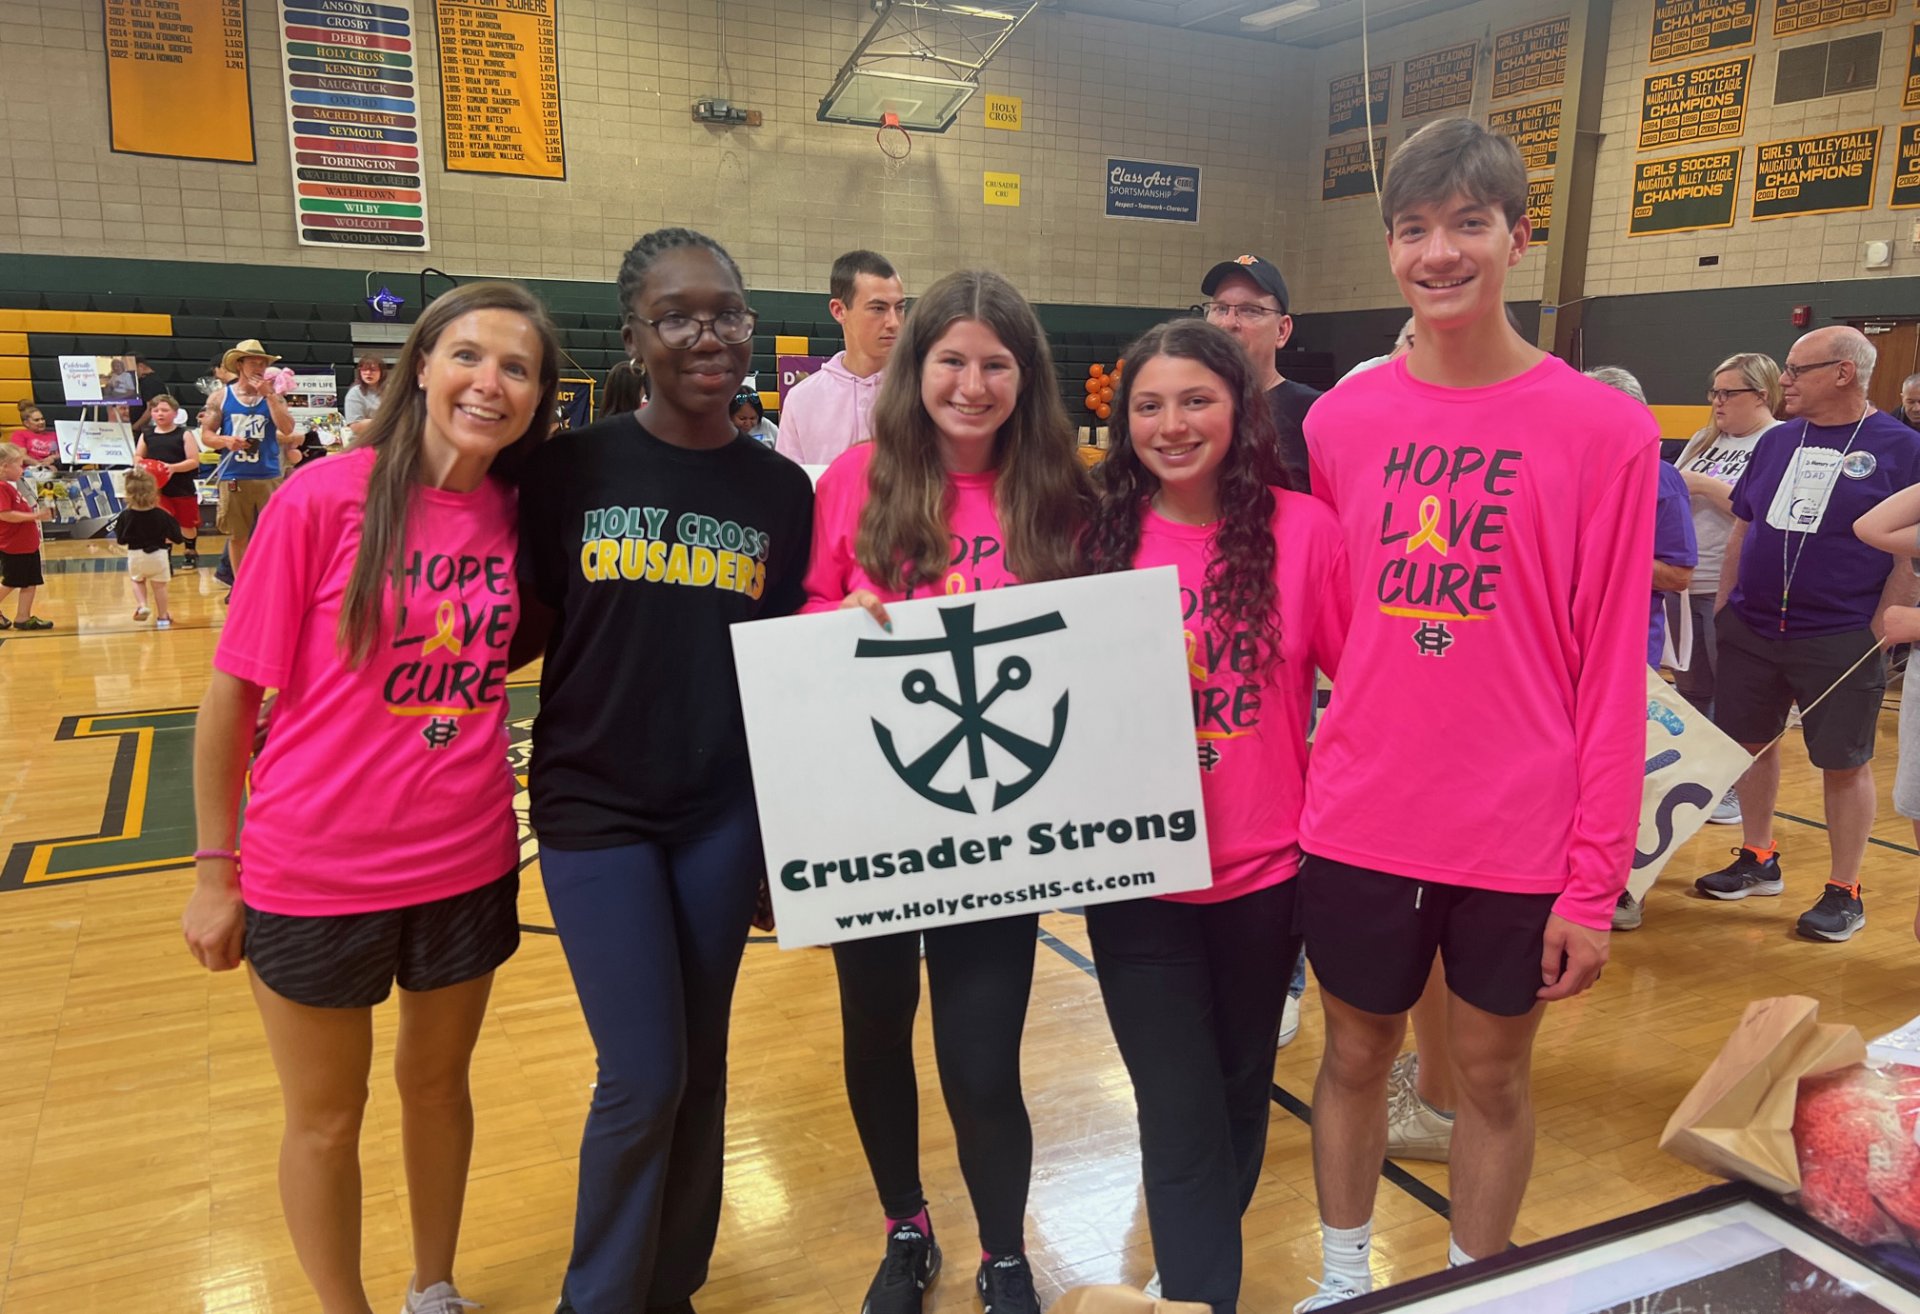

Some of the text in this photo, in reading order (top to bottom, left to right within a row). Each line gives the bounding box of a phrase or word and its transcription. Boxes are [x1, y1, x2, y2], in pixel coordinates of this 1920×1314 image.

[322, 1, 372, 14] ANSONIA
[1656, 1, 1694, 19] NAUGATUCK
[1662, 2, 1746, 31] CHAMPIONS
[326, 17, 370, 30] CROSBY
[1523, 21, 1568, 40] BASKETBAL
[331, 33, 368, 45] DERBY
[316, 47, 385, 62] HOLY CROSS
[1408, 47, 1472, 72] CHEERLEADING
[325, 64, 379, 77] KENNEDY
[1651, 64, 1741, 92] GIRLS SOCCER
[318, 79, 388, 93] NAUGATUCK
[1409, 71, 1467, 93] CHAMPIONS
[1646, 77, 1743, 106] NAUGATUCK VALLEY LEAGUE
[330, 96, 378, 108] OXFORD
[991, 102, 1017, 114] HOLY
[1651, 93, 1734, 118] CHAMPIONS
[313, 109, 396, 125] SACRED HEART
[989, 112, 1018, 123] CROSS
[1491, 102, 1561, 126] GIRLS BASKETBAL
[329, 126, 384, 139] SEYMOUR
[1511, 128, 1559, 145] AMPIONS
[1762, 133, 1872, 160] GIRLS VOLLEYBALL
[320, 156, 396, 170] TORRINGTON
[1643, 155, 1730, 178] GIRLS SOCCER
[1759, 147, 1873, 175] NAUGATUCK VALLEY LEAGUE
[304, 170, 414, 186] WATERBURY CAREER
[1110, 166, 1142, 185] Class
[1143, 171, 1172, 188] Act
[1637, 168, 1733, 192] NAUGATUCK VALLEY LEAGUE
[1766, 163, 1863, 187] CHAMPIONS
[1899, 176, 1918, 186] 2002
[326, 187, 396, 199] WATERTOWN
[985, 180, 1018, 189] CRUSADER
[1110, 186, 1172, 198] SPORTSMANSHIP
[1643, 184, 1723, 204] CHAMPIONS
[1758, 190, 1774, 200] 2001
[344, 204, 380, 214] WILBY
[335, 218, 392, 229] WOLCOTT
[330, 232, 398, 244] WOODLAND
[1383, 442, 1523, 496] HOPE
[1804, 470, 1825, 480] DAD
[582, 506, 770, 562] HOLY CROSS
[388, 551, 511, 598] HOPE
[580, 538, 767, 601] CRUSADERS
[1377, 558, 1502, 618] CURE
[383, 659, 507, 710] CURE
[780, 808, 1197, 893] Crusader Strong
[834, 868, 1156, 930] www.HolyCrossHS-ct.com
